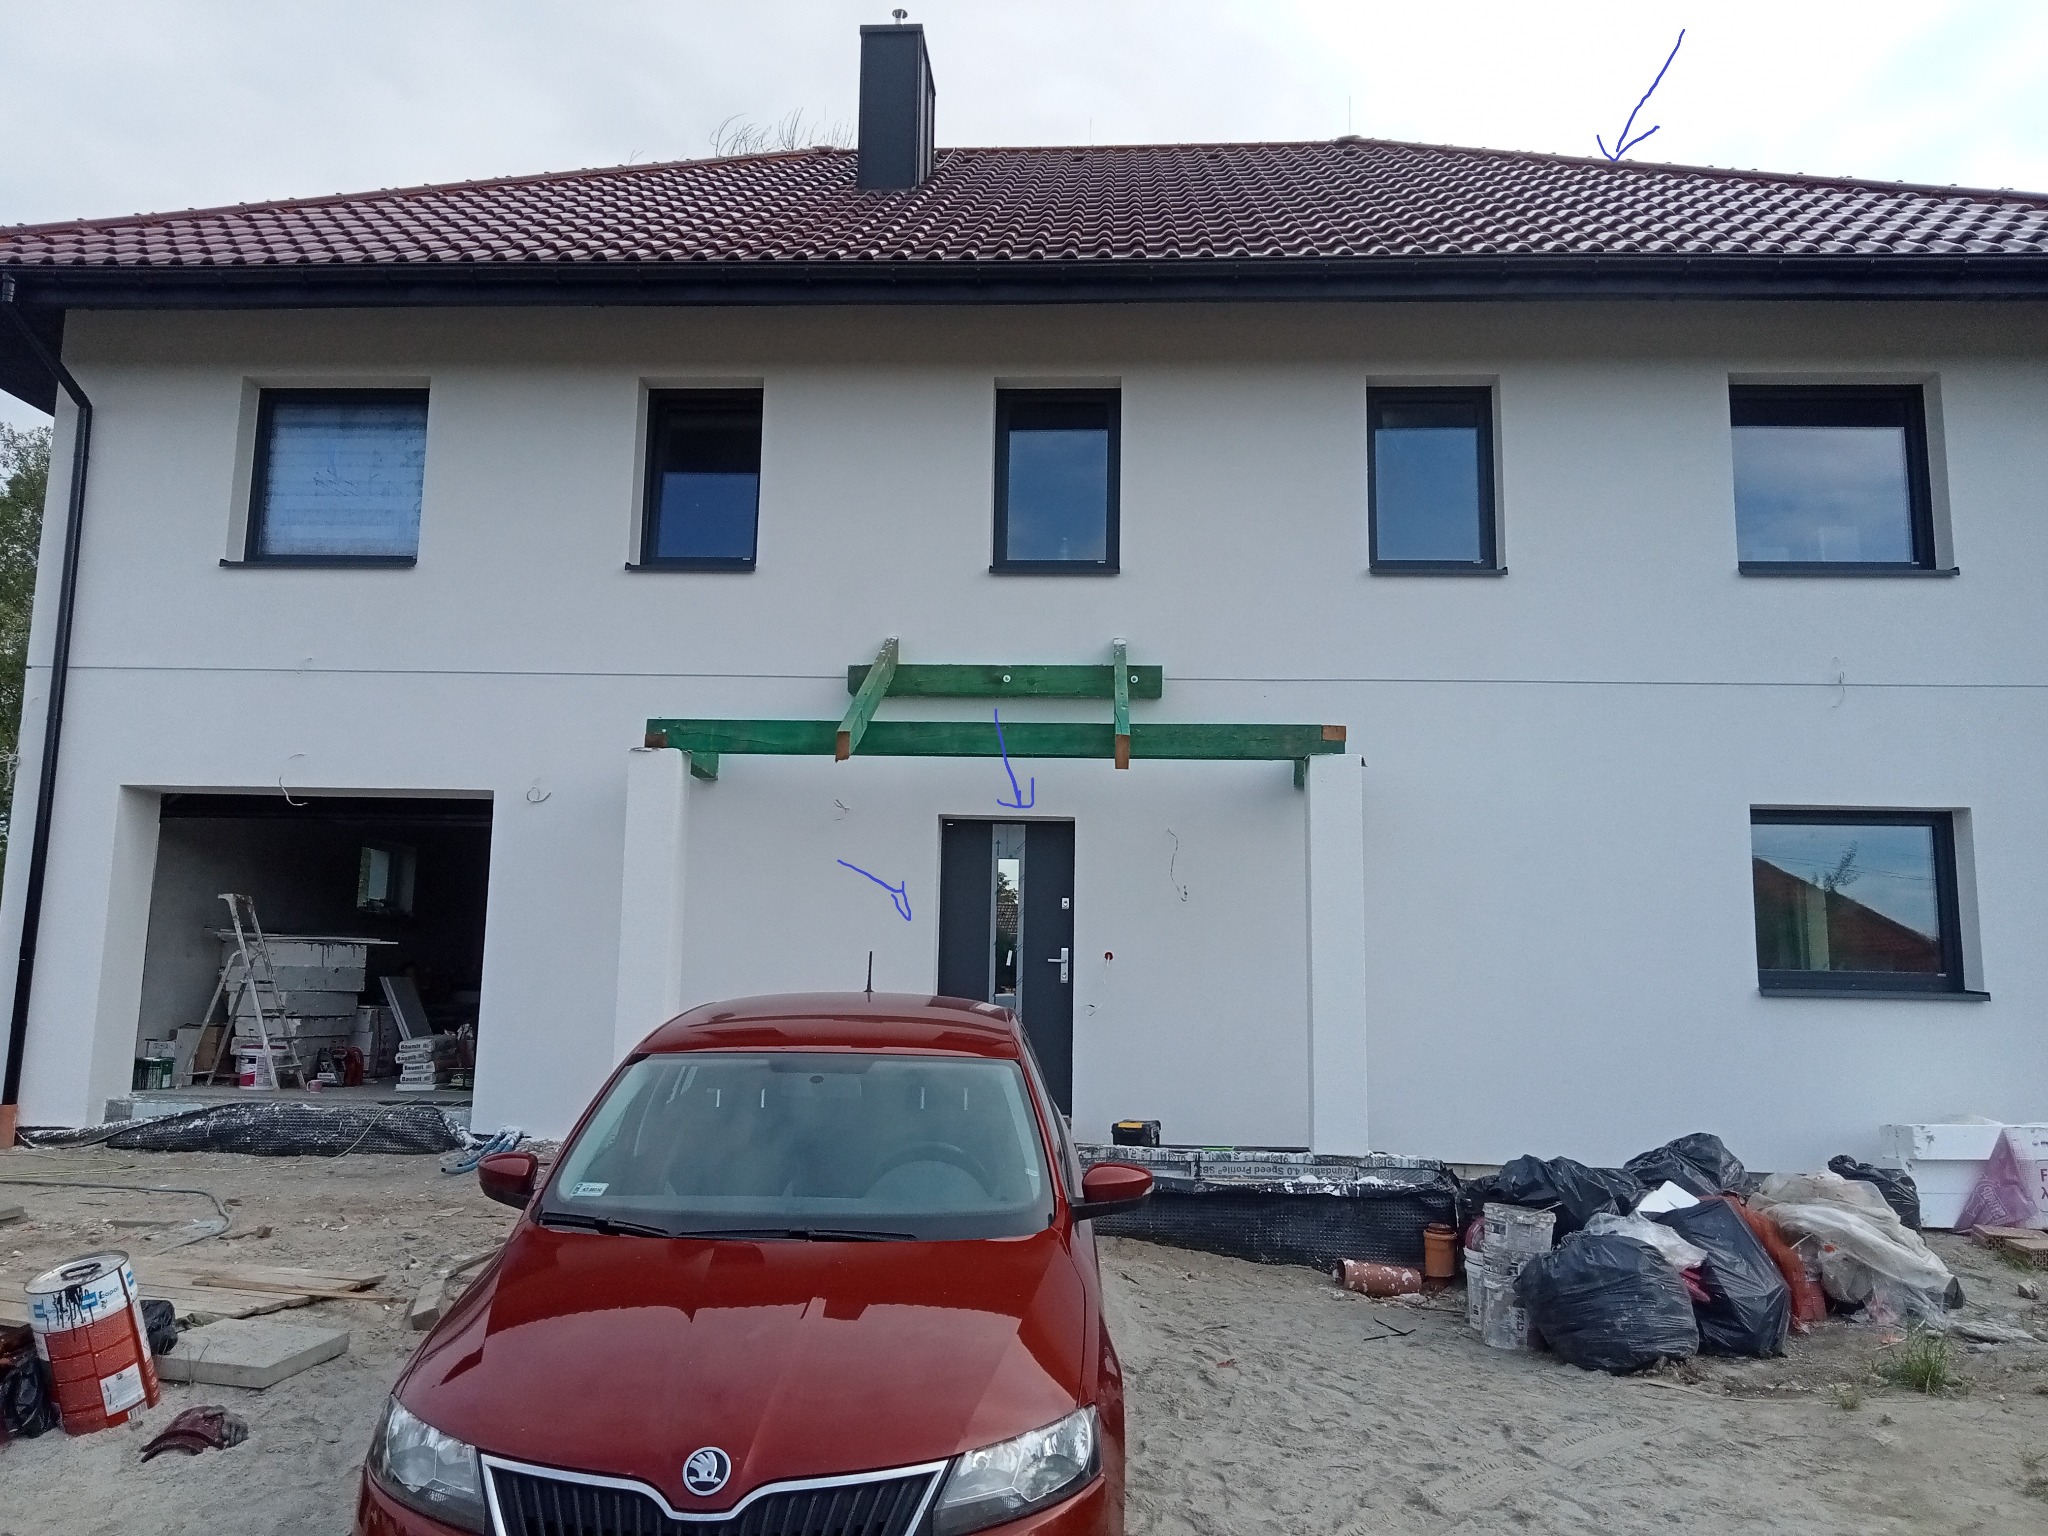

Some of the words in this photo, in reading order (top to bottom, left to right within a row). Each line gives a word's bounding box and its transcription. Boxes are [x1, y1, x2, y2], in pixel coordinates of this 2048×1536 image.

[1254, 1165, 1284, 1175] Speed
[1287, 1167, 1300, 1175] 4.0
[1303, 1166, 1354, 1177] Foundation
